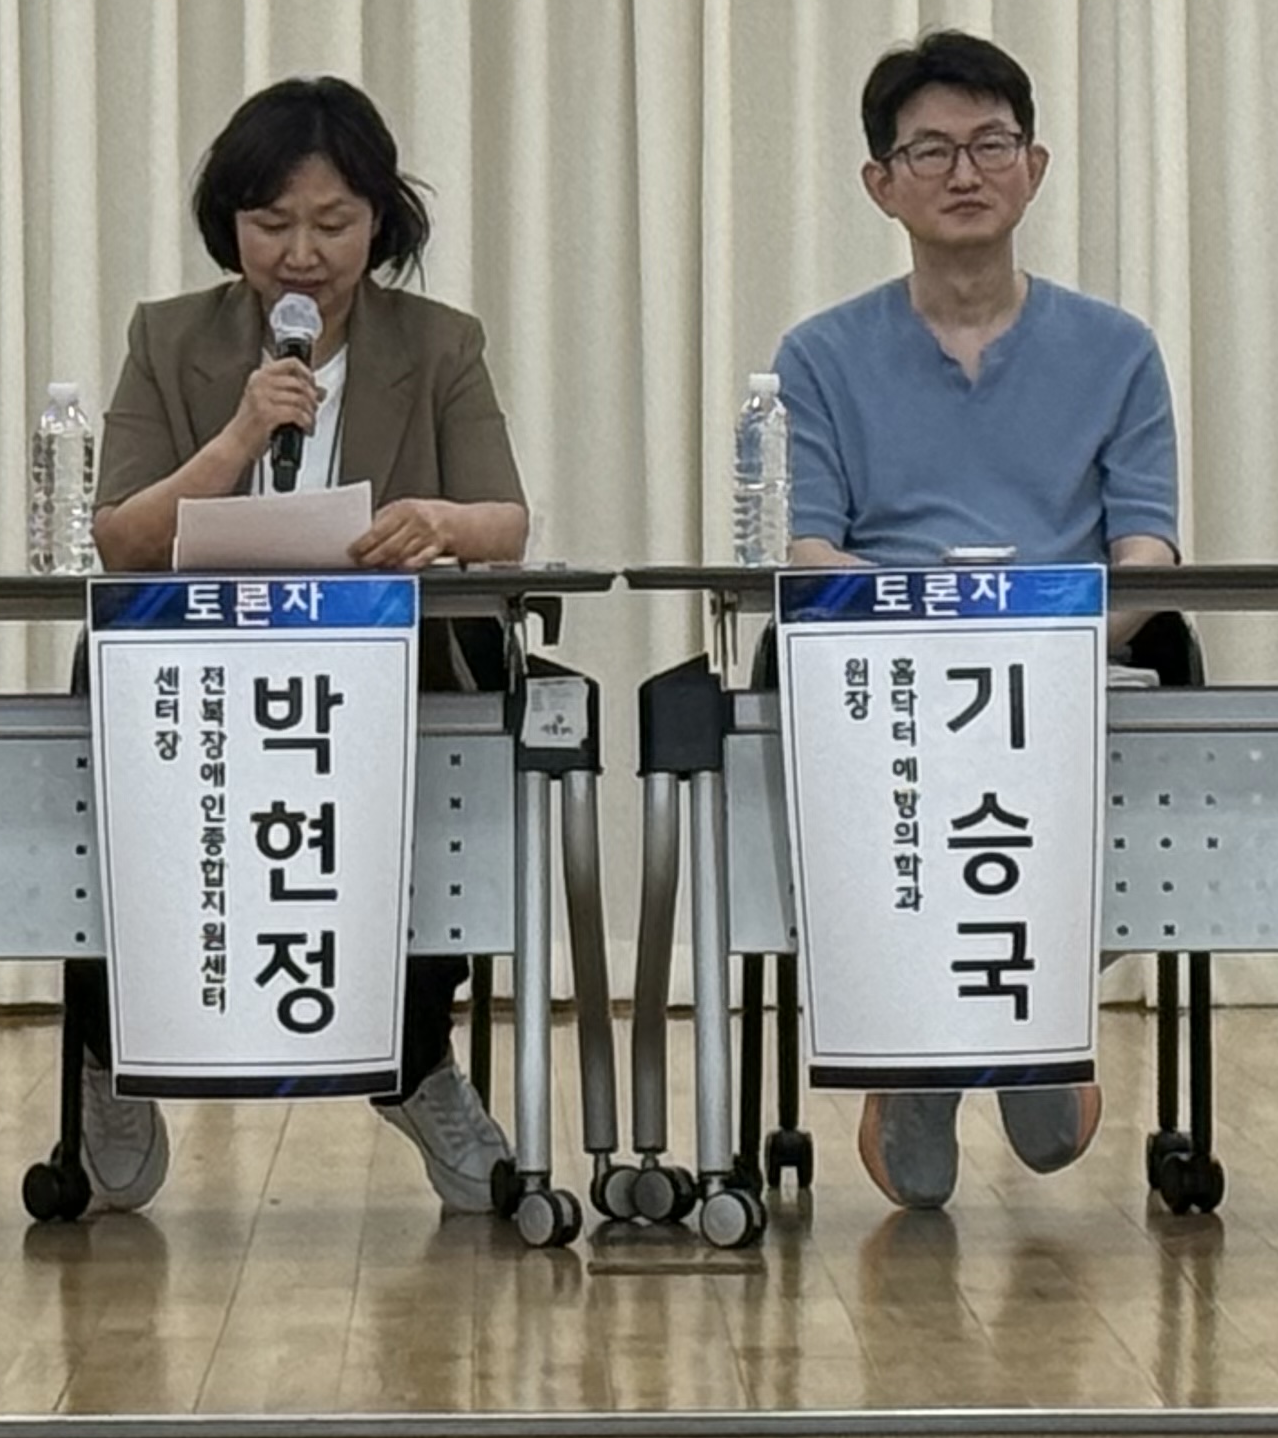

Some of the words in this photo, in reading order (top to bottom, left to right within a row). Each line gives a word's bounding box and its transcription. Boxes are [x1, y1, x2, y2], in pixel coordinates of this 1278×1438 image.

[184, 582, 323, 626] 토론자
[873, 572, 1013, 616] 토론자
[154, 666, 182, 761] 센터장
[250, 674, 344, 1034] 박현정
[946, 663, 1035, 1020] 기승국
